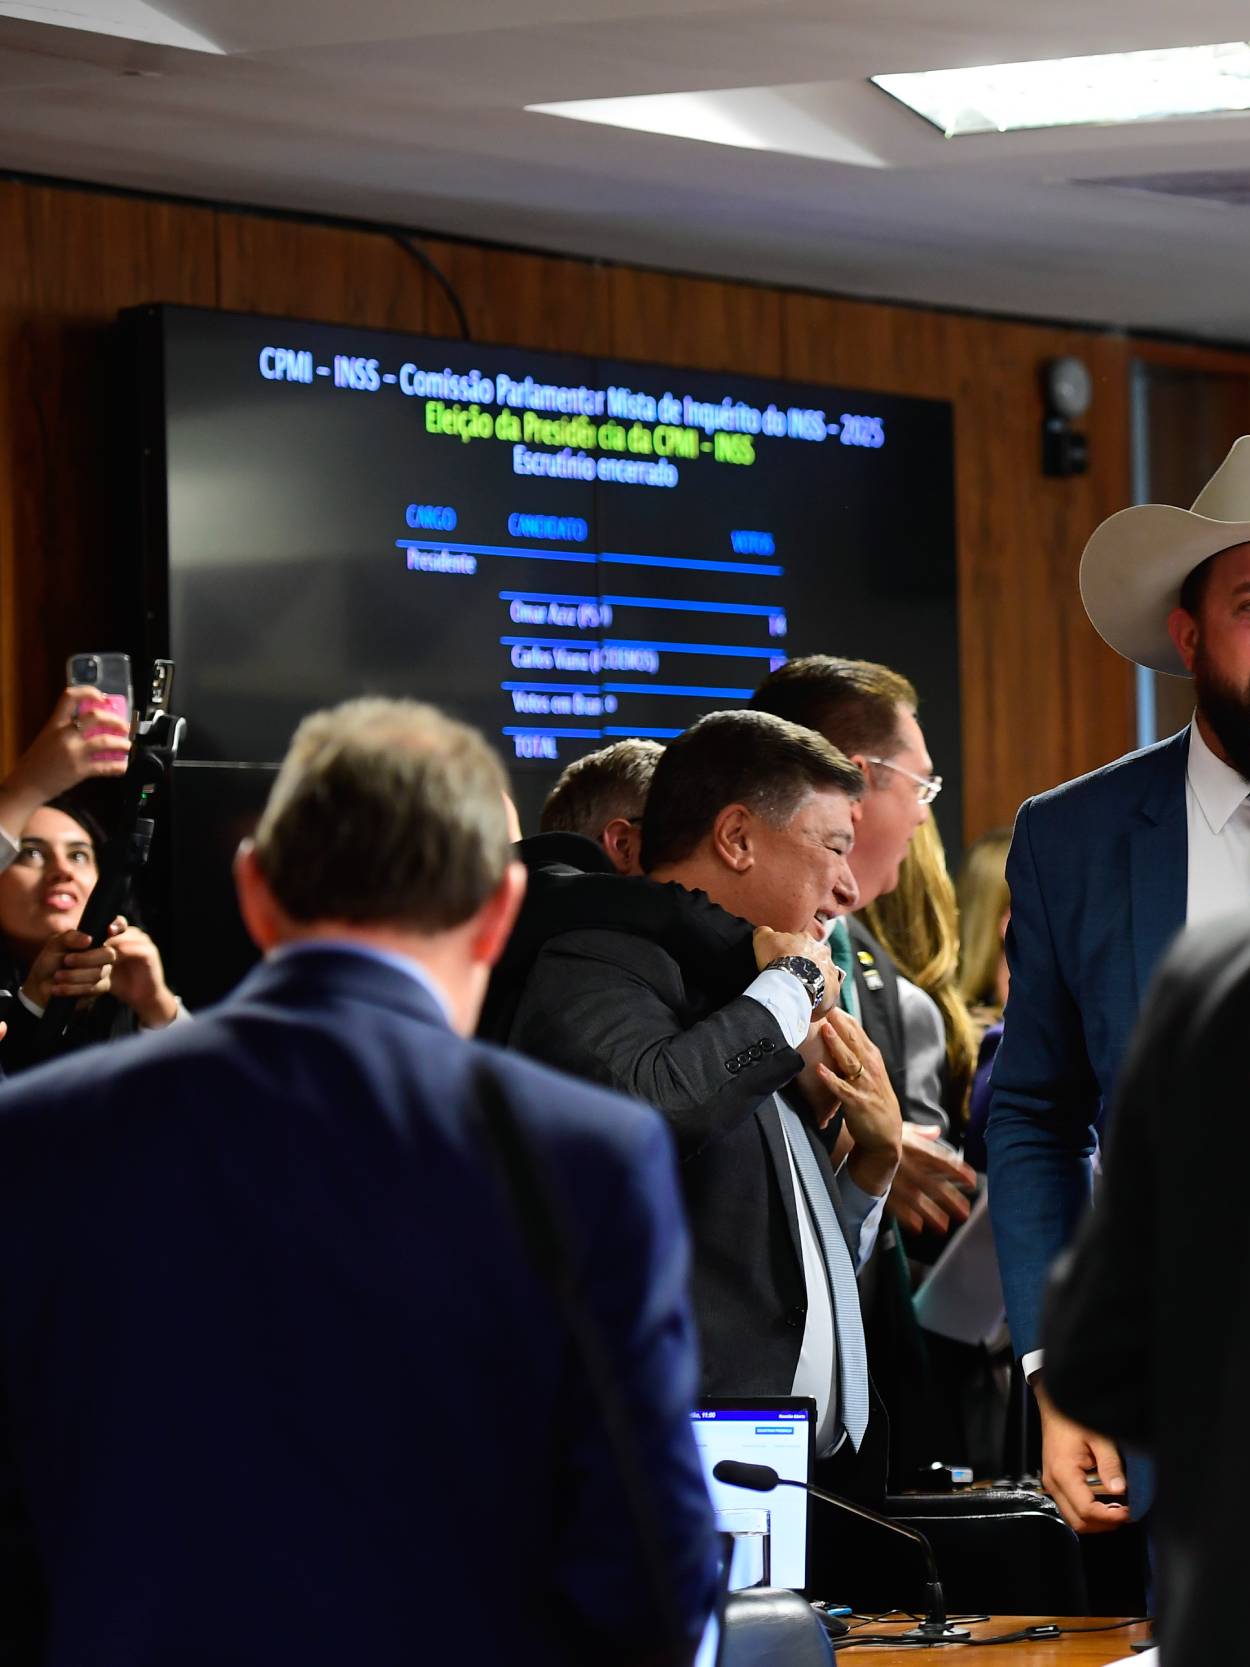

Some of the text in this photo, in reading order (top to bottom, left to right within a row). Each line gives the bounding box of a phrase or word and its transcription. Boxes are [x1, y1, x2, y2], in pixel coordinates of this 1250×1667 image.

[259, 346, 312, 384] CPMI
[334, 355, 380, 391] INSS
[400, 362, 494, 404] Comissão
[496, 373, 605, 416] Parlamentar
[607, 386, 656, 422] Mista
[658, 391, 682, 425] de
[683, 395, 761, 435] Inquérito
[762, 403, 786, 437] do
[787, 407, 827, 442] INSS
[840, 413, 884, 448] 2025
[425, 400, 494, 444] Eleição
[495, 407, 522, 442] da
[627, 421, 652, 454] da
[653, 425, 699, 459] CPMI
[714, 431, 756, 466] INSS
[597, 457, 678, 488] encerrado
[407, 547, 477, 575] Presidente
